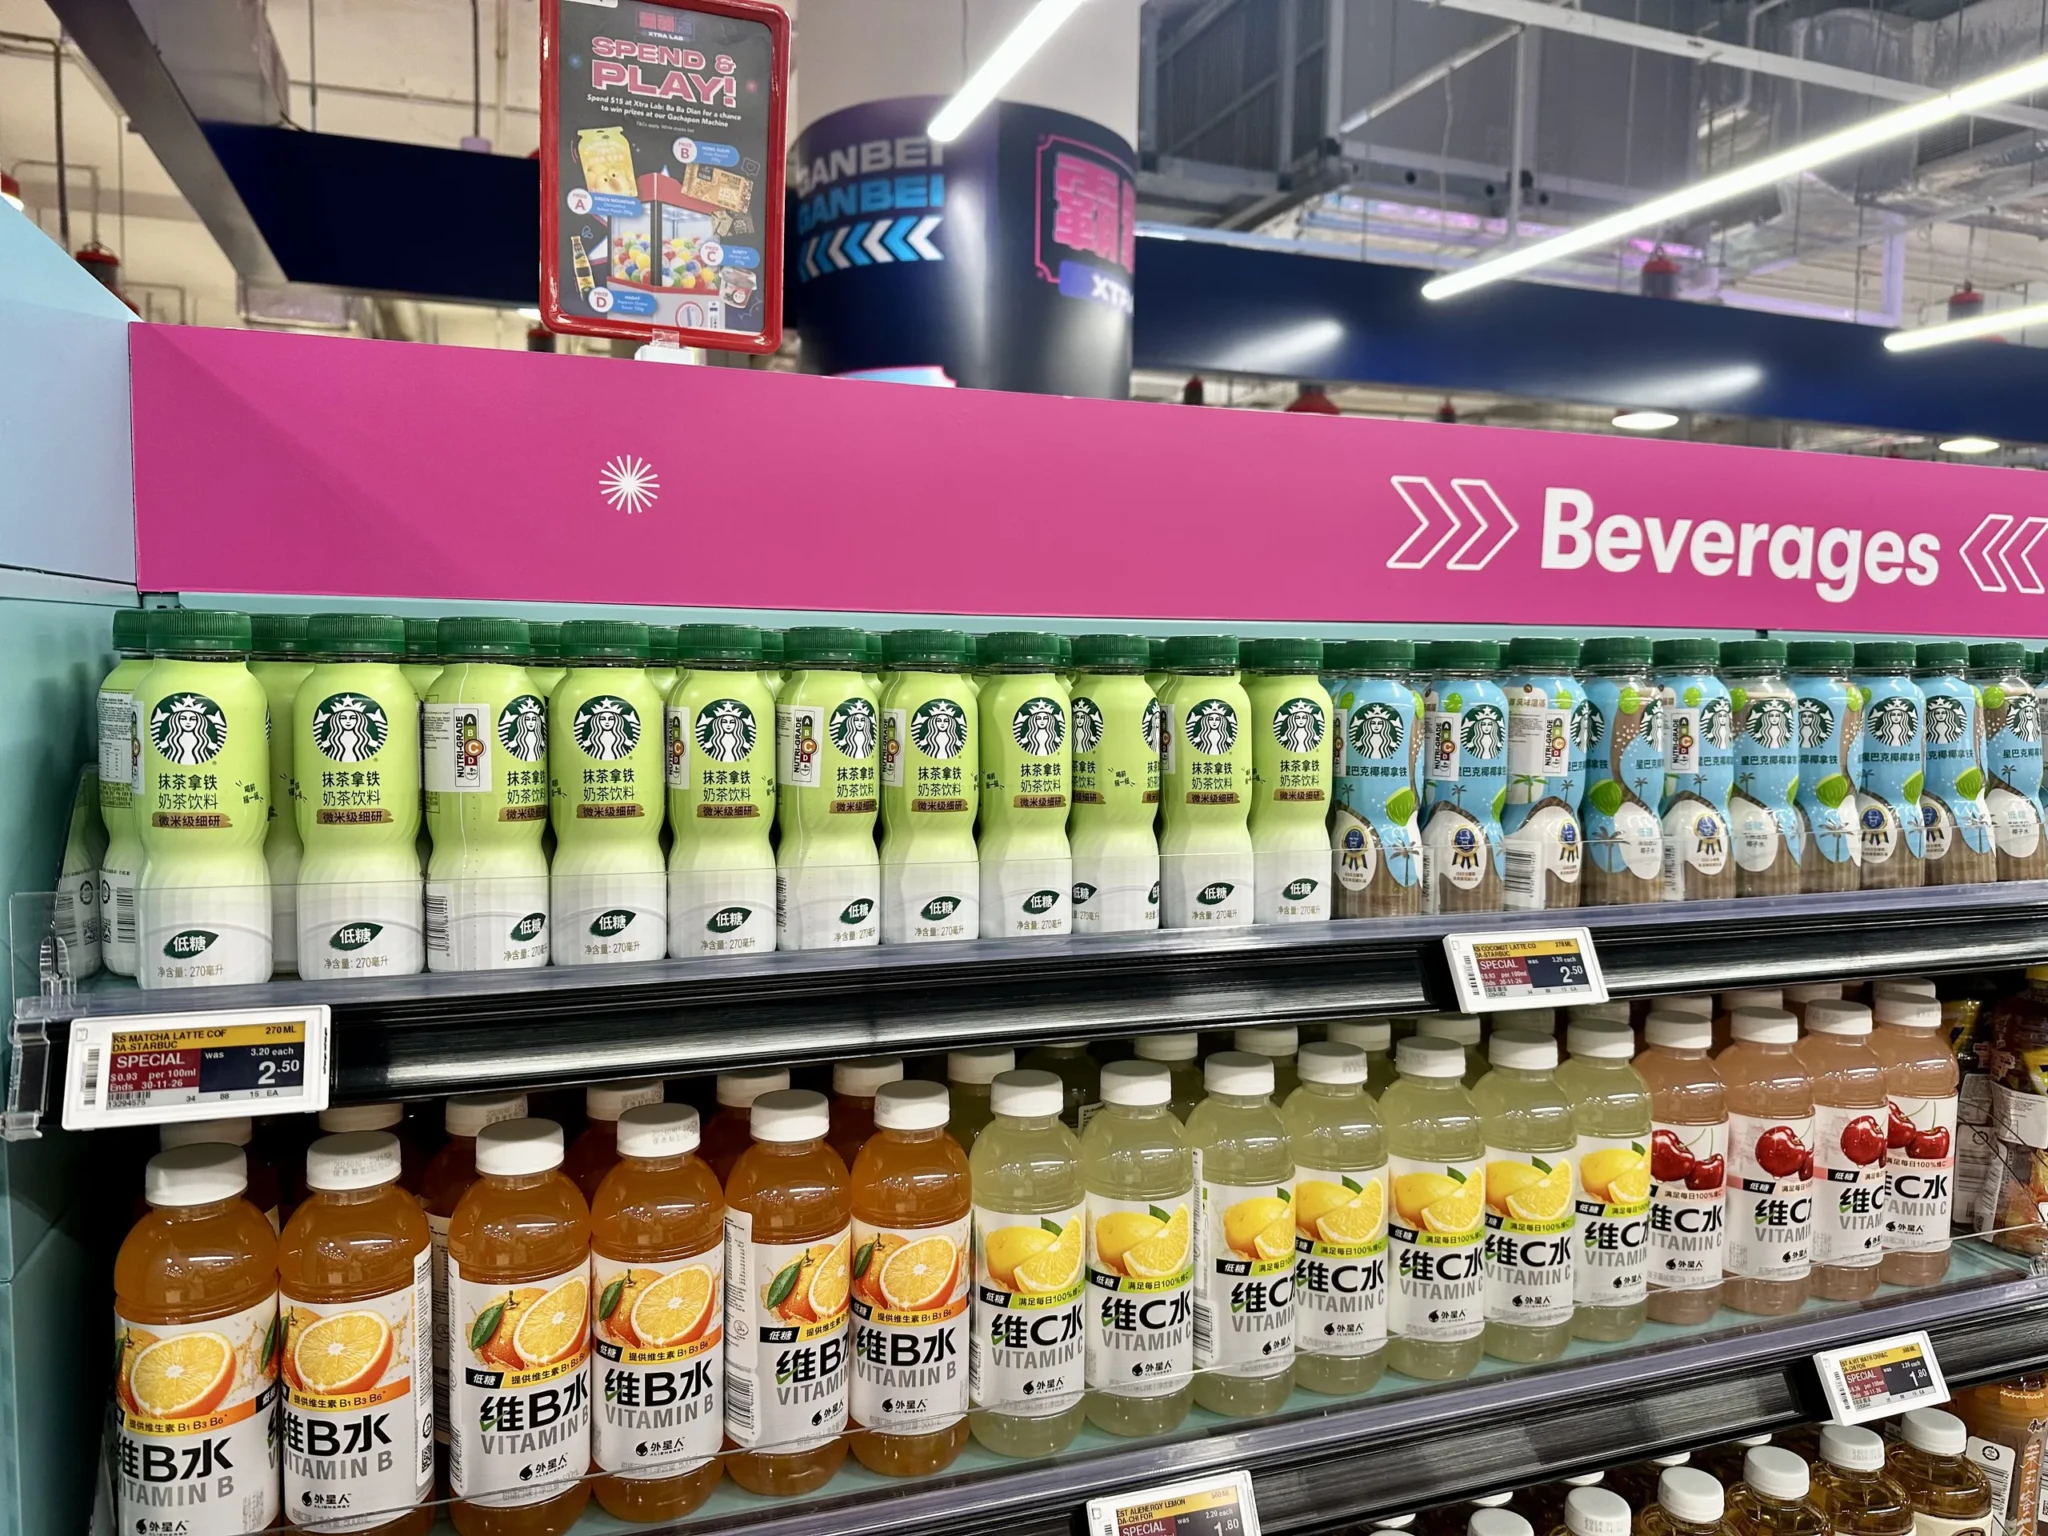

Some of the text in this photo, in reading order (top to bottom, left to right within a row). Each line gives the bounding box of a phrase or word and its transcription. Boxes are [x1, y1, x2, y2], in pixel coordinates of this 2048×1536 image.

[592, 36, 736, 74] SPEND &
[592, 60, 736, 108] PLAY!
[587, 94, 609, 104] Spend
[611, 97, 623, 105] $15
[634, 100, 649, 109] Xtra
[666, 104, 675, 112] Ba
[687, 107, 701, 115] Dian
[703, 109, 712, 117] for
[719, 112, 741, 121] chance
[624, 108, 644, 118] prizes
[668, 114, 700, 125] Gachapon
[702, 118, 728, 127] Machine
[681, 148, 689, 159] B
[575, 200, 585, 210] A
[707, 251, 716, 262] C
[596, 297, 606, 308] D
[1541, 487, 1940, 603] Beverages
[467, 717, 473, 725] A
[456, 715, 464, 778] NUTRI-GRADE
[468, 741, 479, 754] C
[794, 717, 802, 773] NUTRI-GRADE
[803, 741, 813, 752] C
[1545, 720, 1553, 766] NUTRI-GRADE
[1020, 763, 1061, 777] 抹茶拿铁
[1192, 761, 1232, 775] 抹茶拿铁
[1280, 759, 1319, 772] 抹茶拿铁
[322, 771, 380, 787] 抹茶拿铁
[583, 768, 634, 784] 抹茶拿铁
[703, 770, 750, 785] 抹茶拿铁
[918, 766, 961, 780] 抹茶拿铁
[158, 773, 217, 790] 抹茶拿铁
[1020, 779, 1061, 793] 奶茶饮料
[1192, 777, 1232, 790] 奶茶饮料
[1280, 774, 1319, 787] 奶茶饮料
[584, 786, 635, 802] 奶茶饮料
[703, 787, 751, 802] 奶茶饮料
[918, 783, 961, 796] 奶茶饮料
[158, 794, 218, 810] 奶茶饮料
[323, 789, 380, 806] 奶茶饮料
[158, 815, 220, 827] 微米级细研
[323, 810, 383, 823] 微米级细研
[1205, 887, 1227, 900] 低糖
[1290, 882, 1311, 895] 低糖
[929, 902, 953, 915] 低糖
[1030, 895, 1052, 908] 低糖
[599, 915, 626, 930] 低糖
[716, 912, 743, 927] 低糖
[340, 928, 371, 944] 低糖
[173, 936, 206, 951] 低糖
[1481, 959, 1519, 970] SPECIAL
[113, 1029, 226, 1043] KS MATCHA LATTE COF
[112, 1041, 178, 1052] DA-STARBUC
[251, 1047, 294, 1056] 3.20 each
[117, 1052, 186, 1069] SPECIAL
[205, 1051, 224, 1059] was
[110, 1068, 196, 1082] $0.93 per 100ml
[110, 1079, 183, 1092] Ends 30-11-26
[266, 1089, 278, 1097] EA
[1835, 1172, 1854, 1180] 低糖
[1750, 1182, 1769, 1192] 低糖
[1395, 1229, 1412, 1240] 低糖
[1485, 1234, 1571, 1267] 维C水
[1225, 1263, 1245, 1273] 低糖
[1400, 1247, 1483, 1281] 维C水
[1096, 1275, 1114, 1287] 低糖
[1296, 1259, 1384, 1293] 维C水
[1485, 1262, 1561, 1286] VITAMIN
[1400, 1278, 1475, 1300] VITAMIN
[986, 1292, 1005, 1304] 低糖
[1296, 1289, 1374, 1312] VITAMIN
[1102, 1290, 1191, 1331] 维C水
[878, 1313, 919, 1323] 提供维生素
[922, 1314, 930, 1322] B1
[991, 1304, 1083, 1348] 维C水
[1337, 1323, 1363, 1332] 外星人
[769, 1331, 792, 1340] 低糖
[1102, 1326, 1182, 1351] VITAMIN
[857, 1325, 956, 1366] 维B水
[629, 1350, 674, 1362] 提供维生素
[689, 1345, 698, 1353] B3
[992, 1342, 1074, 1369] VITAMIN
[1145, 1360, 1172, 1372] 外星人
[473, 1374, 496, 1386] 低糖
[511, 1367, 559, 1384] 提供维生素
[857, 1359, 956, 1388] VITAMIN B
[1846, 1370, 1877, 1384] SPECIAL
[605, 1358, 713, 1407] 维B水
[1037, 1377, 1064, 1389] 外星人
[340, 1399, 351, 1407] B1
[480, 1369, 588, 1432] 维B水
[895, 1400, 926, 1410] 外星人
[605, 1393, 713, 1429] VITAMIN B
[193, 1420, 207, 1430] B3
[481, 1414, 578, 1455] VITAMIN
[651, 1438, 684, 1452] 外星人
[378, 1450, 393, 1472] B
[536, 1455, 568, 1473] 外星人
[218, 1475, 234, 1498] B
[314, 1493, 350, 1505] 外星人
[1165, 1498, 1186, 1507] LEMON
[1118, 1513, 1153, 1525] DA-CHI FOR
[1205, 1508, 1233, 1518] 2.20 each
[149, 1520, 188, 1532] 外星人
[1123, 1520, 1166, 1536] SPECIAL
